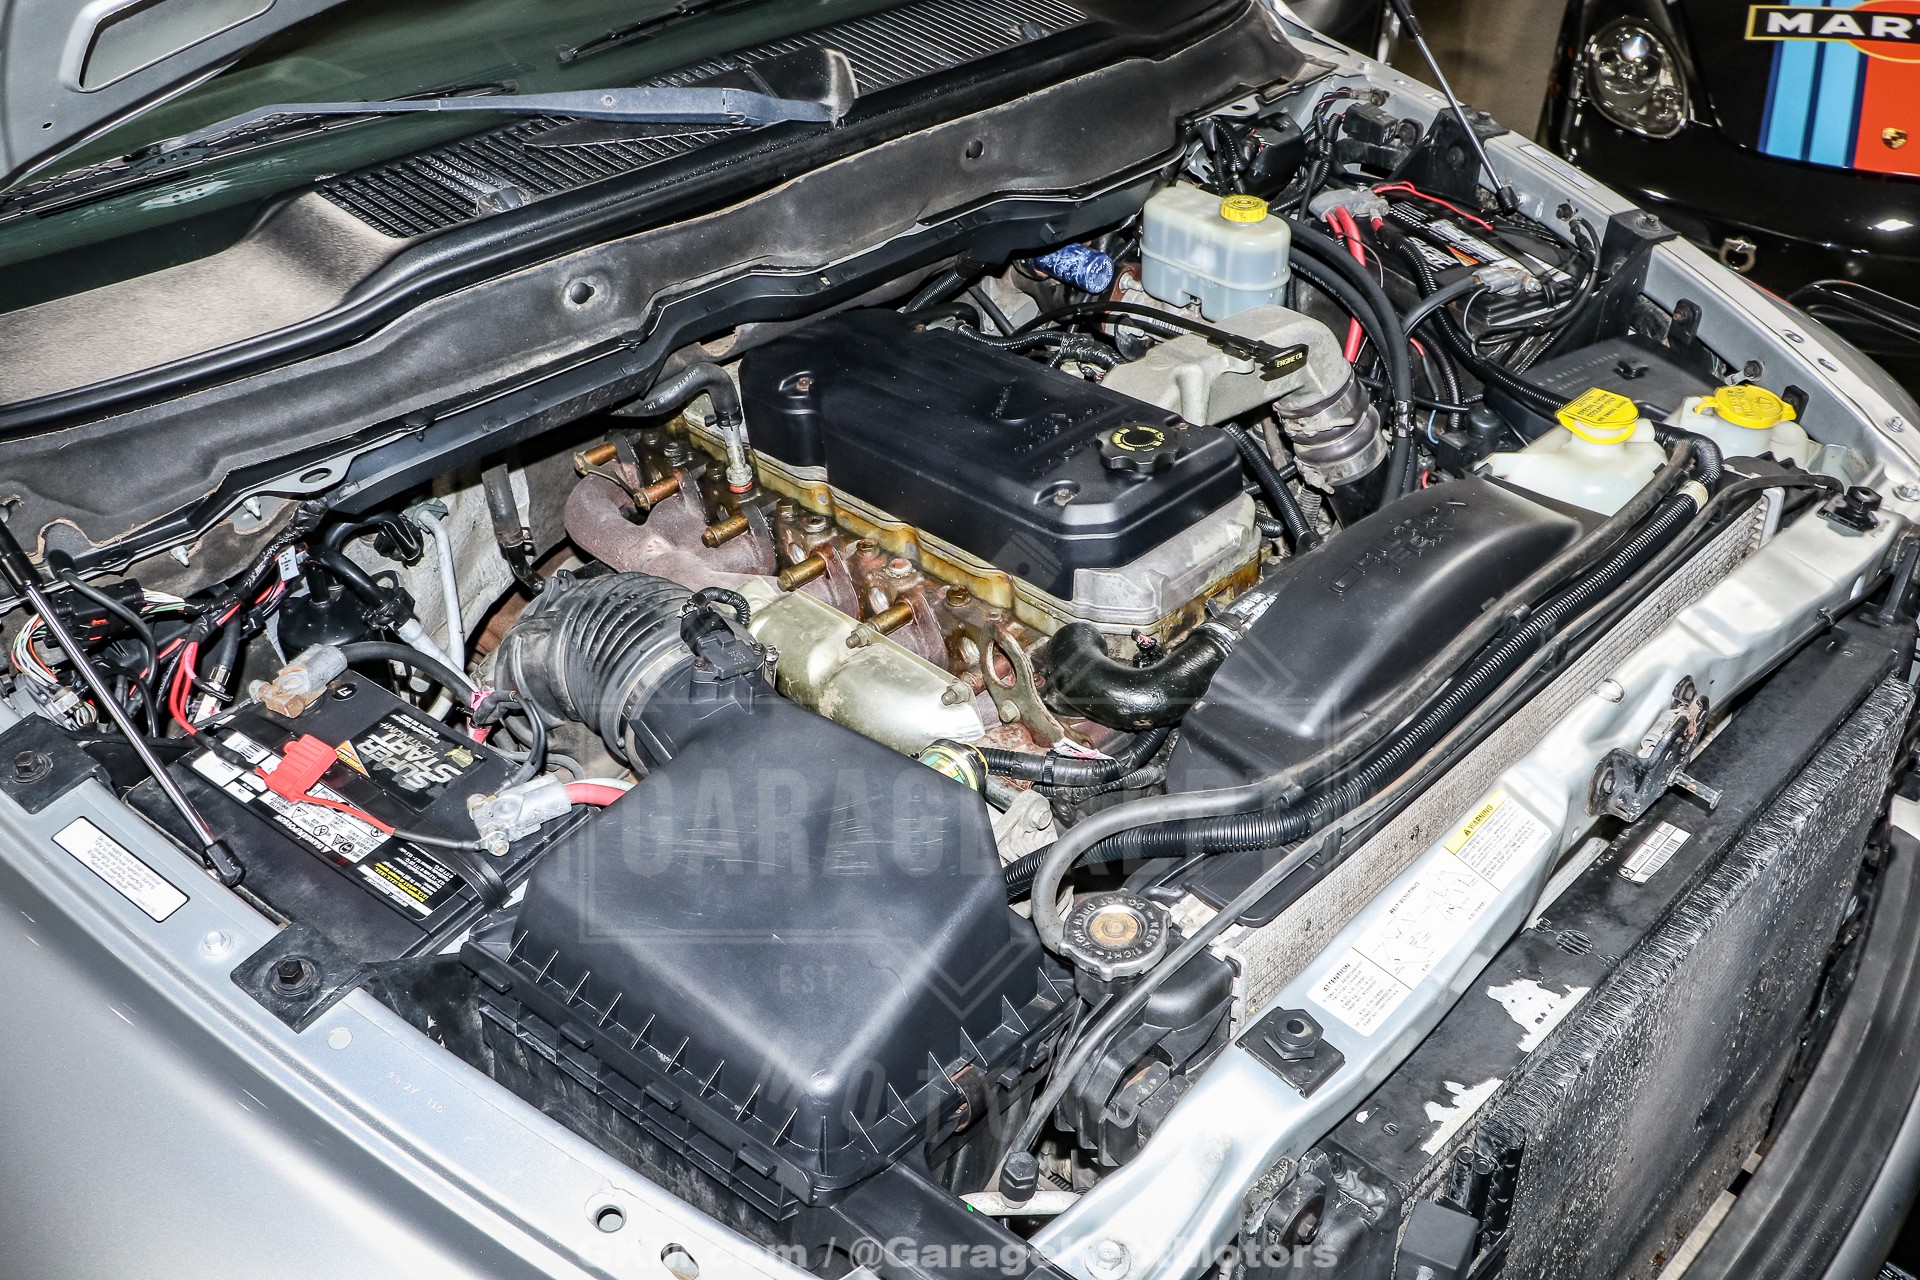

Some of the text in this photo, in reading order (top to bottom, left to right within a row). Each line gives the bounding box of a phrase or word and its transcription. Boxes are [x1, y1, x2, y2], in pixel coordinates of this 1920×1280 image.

[1767, 12, 1920, 39] MAR
[1275, 355, 1296, 368] ENGINE
[356, 739, 429, 790] SUPER
[368, 733, 463, 783] START
[1467, 802, 1494, 831] WARNING
[85, 849, 143, 894] Engine and starting system
[89, 859, 104, 871] failure
[102, 869, 116, 880] could
[91, 847, 112, 863] charging
[114, 864, 128, 875] jump
[125, 873, 145, 888] starting
[103, 840, 113, 848] not
[110, 845, 124, 856] apply
[122, 854, 135, 865] more
[133, 862, 146, 872] than
[143, 870, 162, 885] nominal
[106, 850, 128, 866] electrical
[125, 864, 143, 878] system
[140, 876, 157, 889] during
[1388, 880, 1421, 914] BELT ROUTING
[1145, 921, 1162, 948] KEEP
[1321, 962, 1351, 992] ATTENTION
